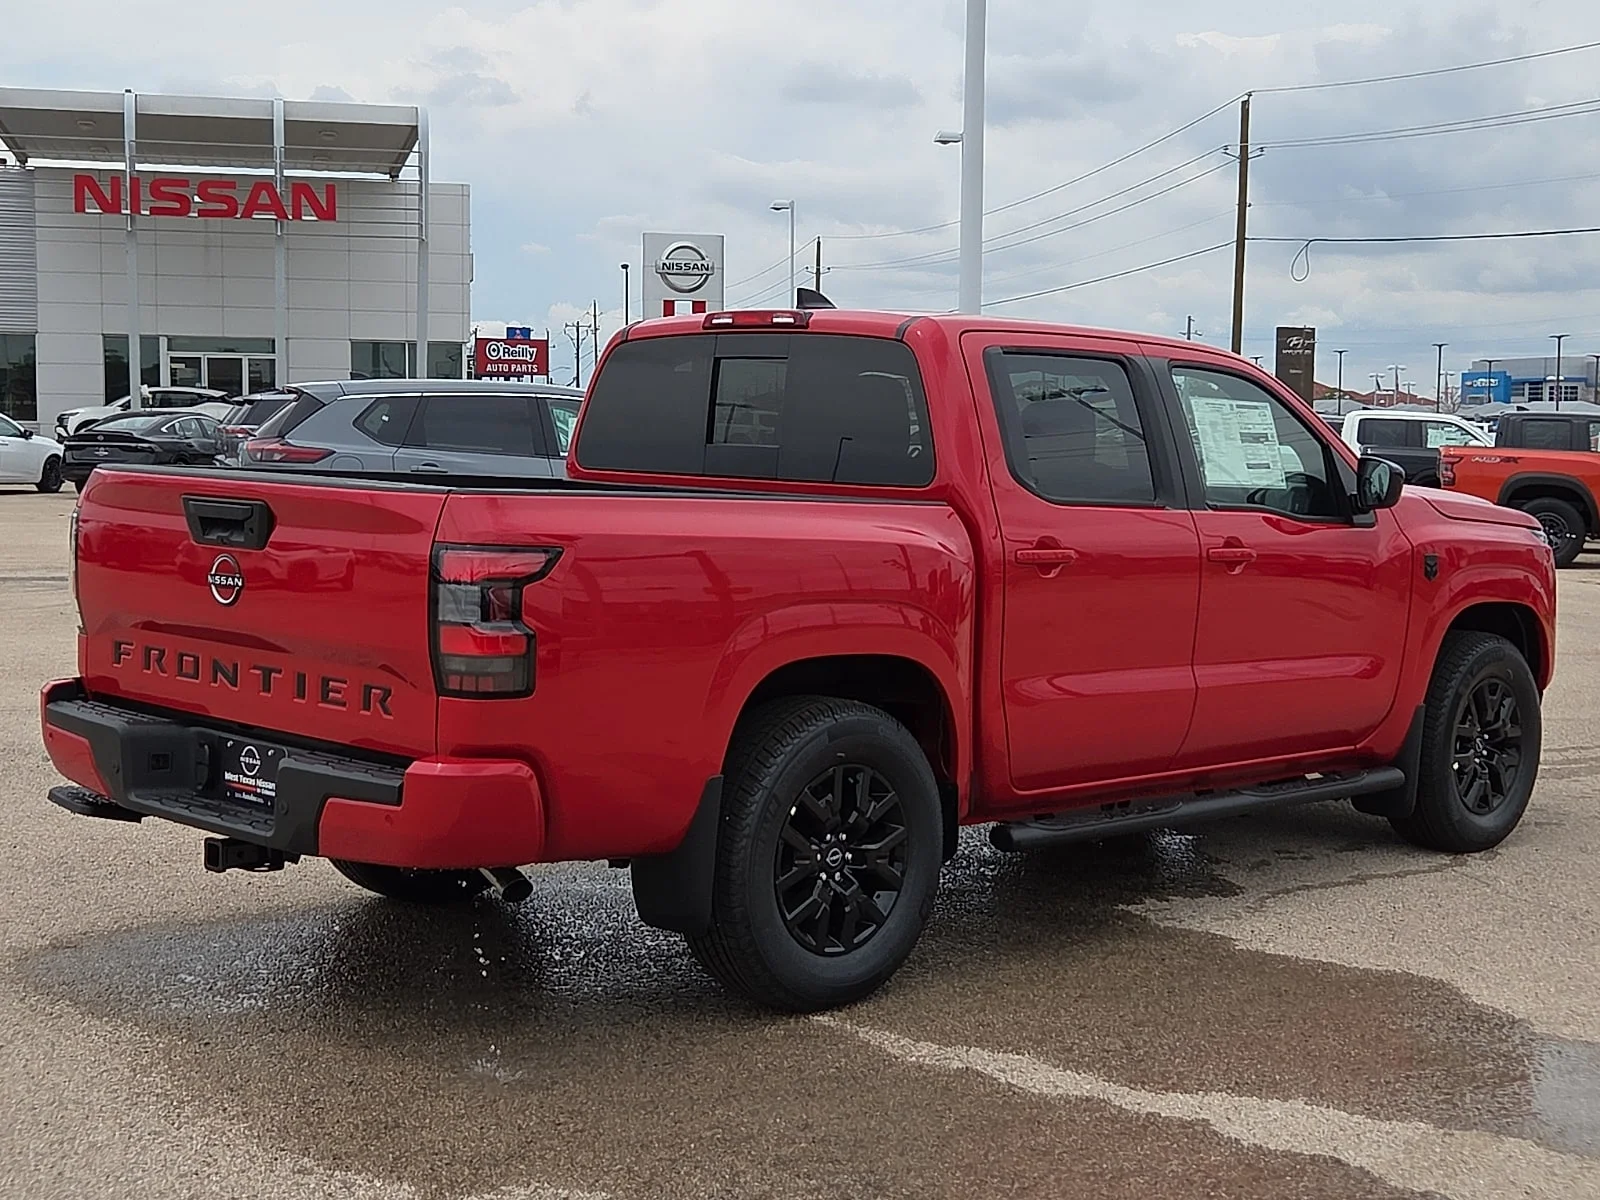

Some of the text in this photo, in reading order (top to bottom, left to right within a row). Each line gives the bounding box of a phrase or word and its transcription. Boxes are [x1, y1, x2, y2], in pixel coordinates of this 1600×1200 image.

[73, 174, 337, 222] NISSAN
[661, 261, 710, 272] NISSAN
[487, 342, 536, 362] O'Reilly
[486, 363, 538, 373] AUTO PARTS
[207, 574, 243, 587] NISSAN
[112, 639, 394, 720] FRONTIER
